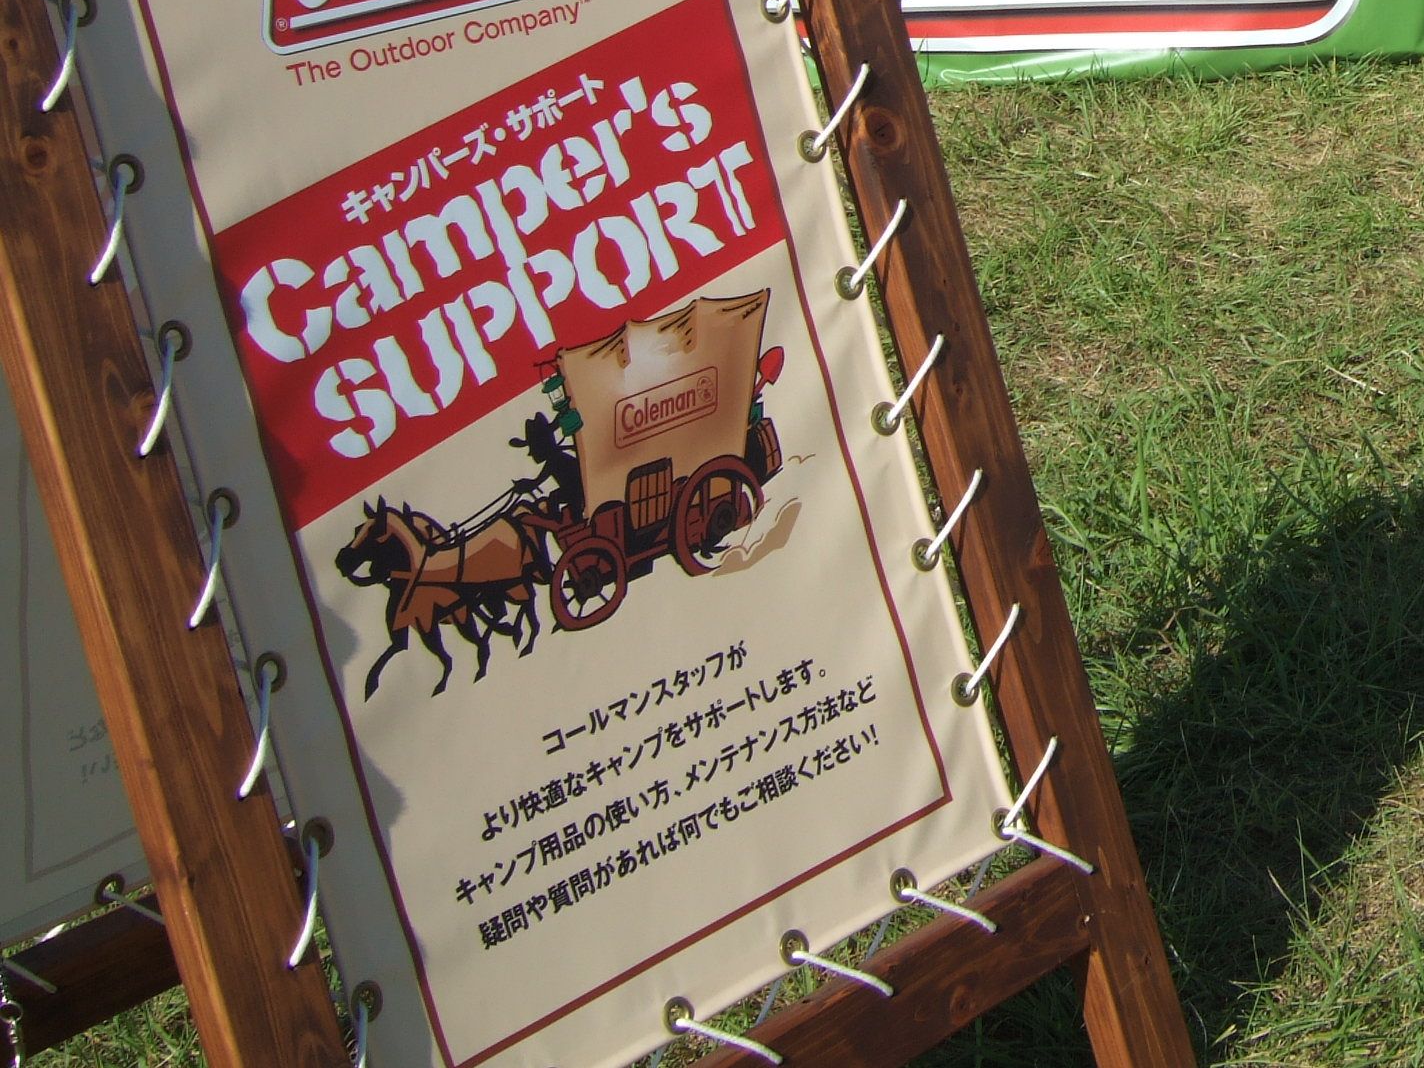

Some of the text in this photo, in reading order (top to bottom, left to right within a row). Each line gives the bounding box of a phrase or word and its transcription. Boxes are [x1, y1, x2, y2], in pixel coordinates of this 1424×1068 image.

[286, 59, 341, 87] The
[349, 31, 456, 72] Outdoor
[240, 76, 712, 364] Camper's
[341, 73, 604, 225] キャンパーズ・サポート
[314, 141, 756, 460] SUPPORT
[621, 387, 697, 434] Coleman
[480, 659, 828, 843] より快適なキャンプをサポートします。
[542, 640, 748, 755] コールマンスタッフが
